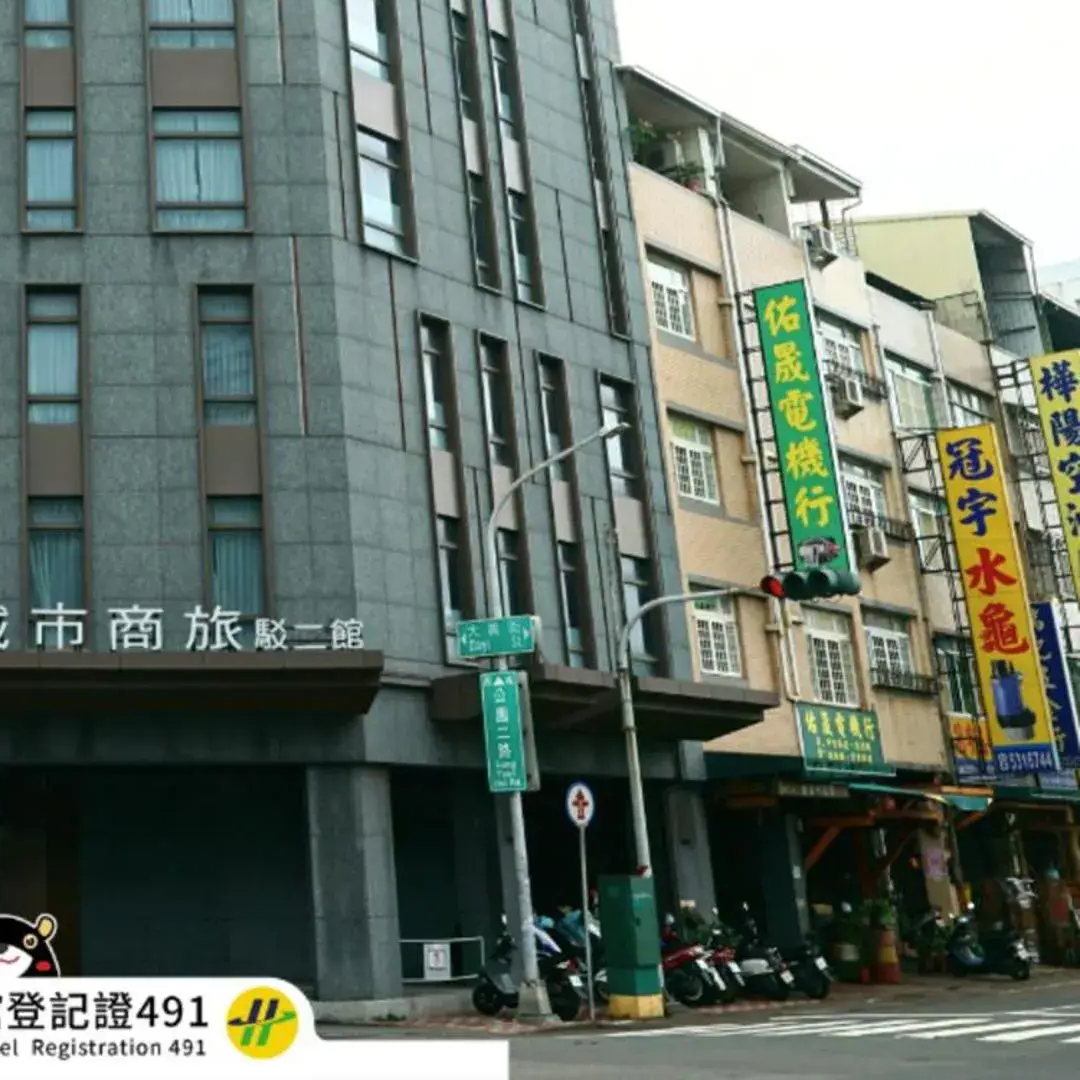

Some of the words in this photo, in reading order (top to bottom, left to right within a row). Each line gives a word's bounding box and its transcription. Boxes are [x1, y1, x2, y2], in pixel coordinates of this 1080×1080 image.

[764, 295, 833, 528] 佑晟電機行
[255, 618, 366, 651] 駁二館
[944, 437, 1030, 655] 冠宇水龜
